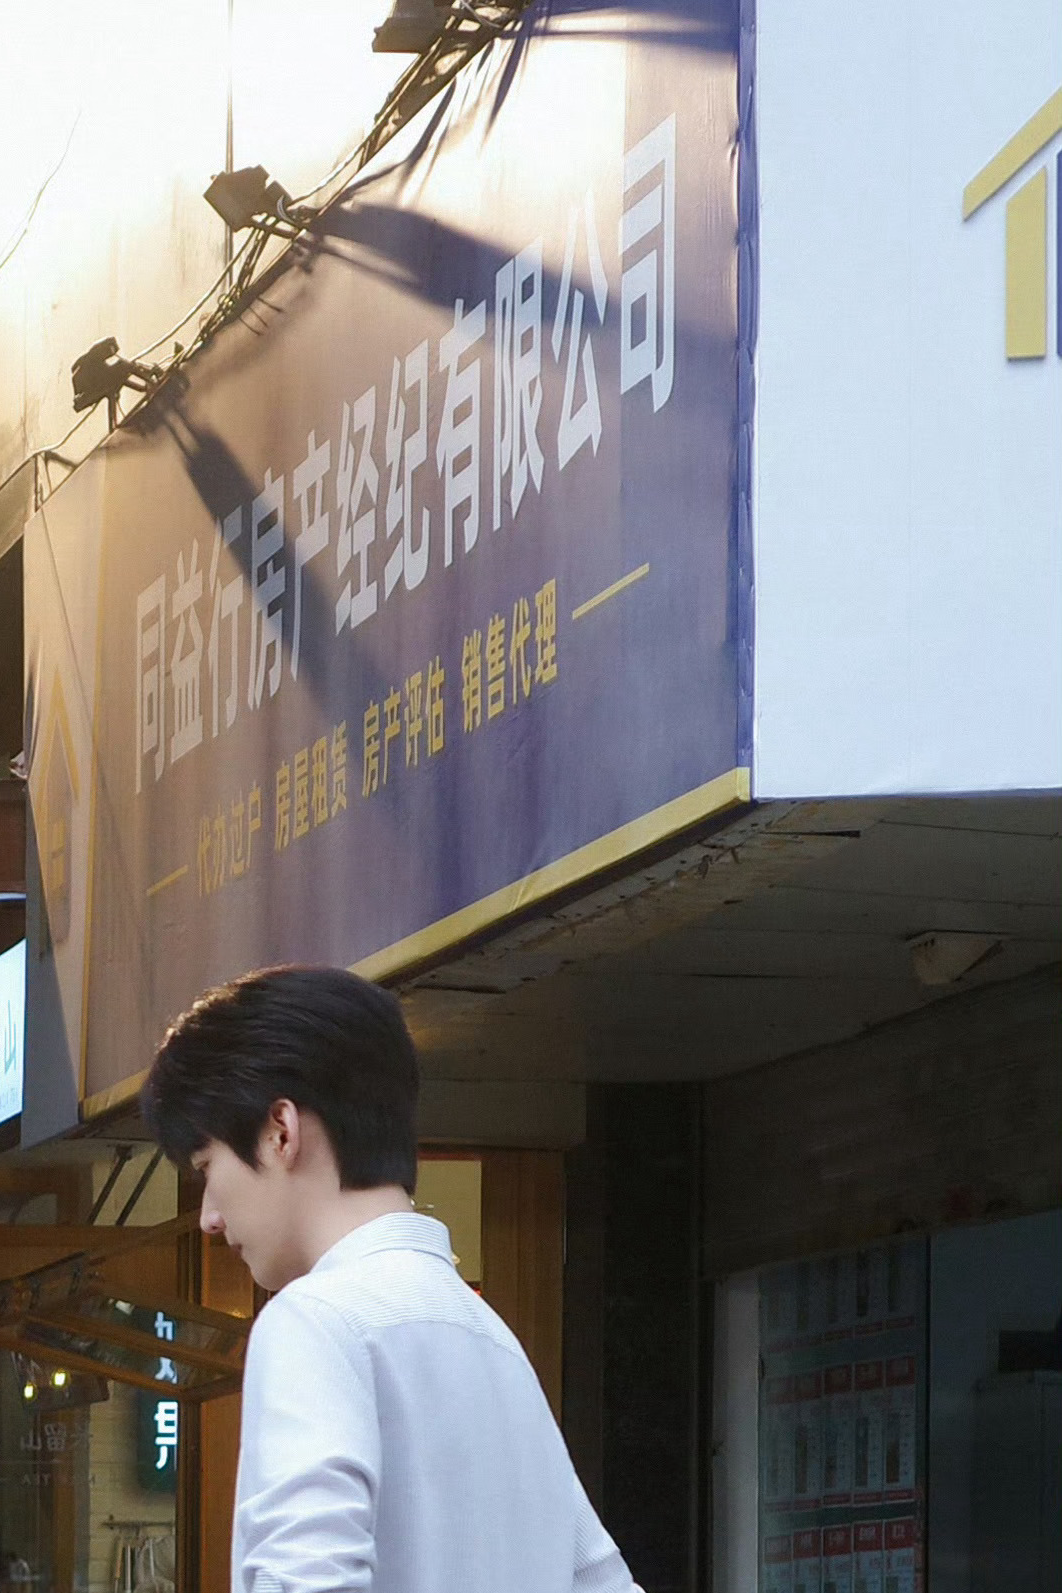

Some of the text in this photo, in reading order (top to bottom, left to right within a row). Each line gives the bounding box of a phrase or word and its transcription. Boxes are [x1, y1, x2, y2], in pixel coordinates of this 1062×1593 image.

[136, 112, 676, 795] 同益行房产经纪有限公司
[275, 720, 347, 853] 房屋租赁
[362, 655, 445, 798] 房产评估
[461, 578, 558, 734] 销售代理
